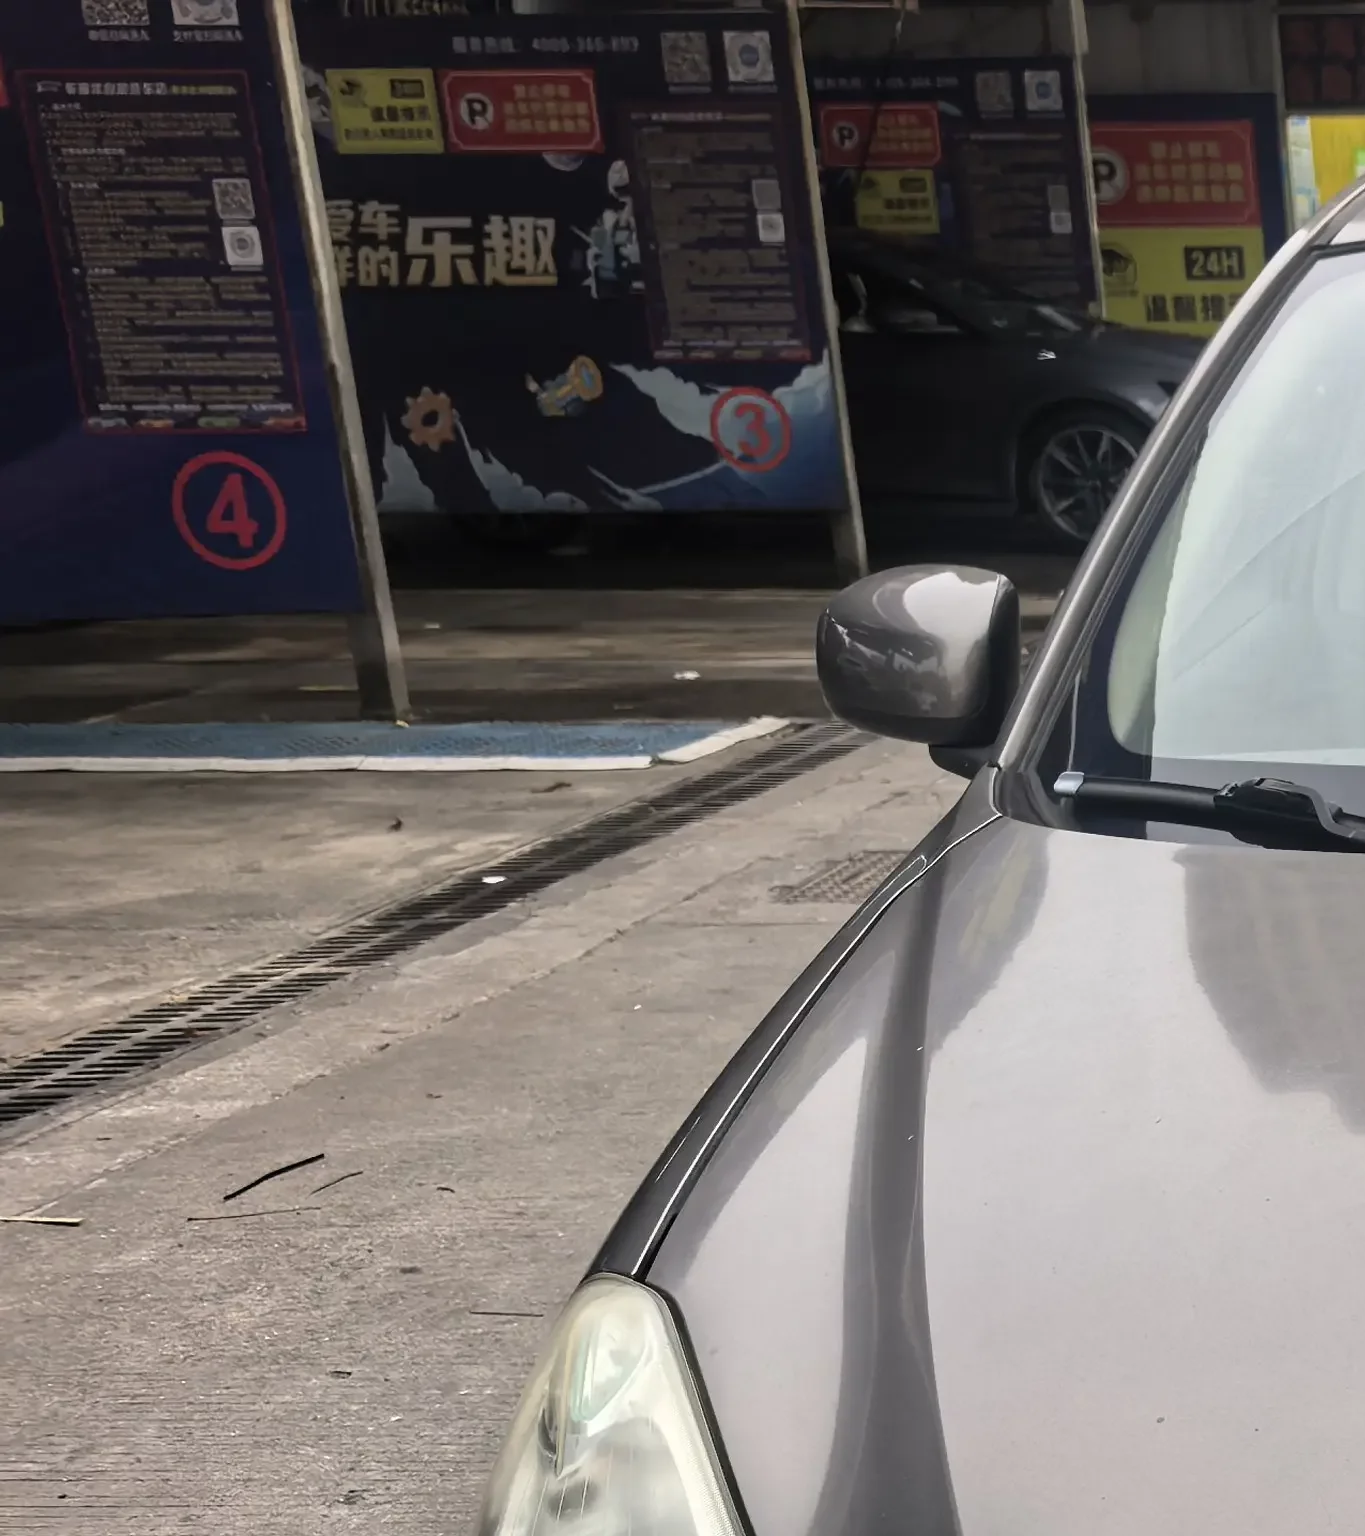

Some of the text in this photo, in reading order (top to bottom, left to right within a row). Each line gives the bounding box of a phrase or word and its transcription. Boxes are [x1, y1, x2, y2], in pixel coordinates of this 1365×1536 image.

[404, 215, 558, 287] 乐趣
[1191, 249, 1240, 278] 24H
[730, 403, 772, 457] 3
[207, 473, 257, 547] 4
